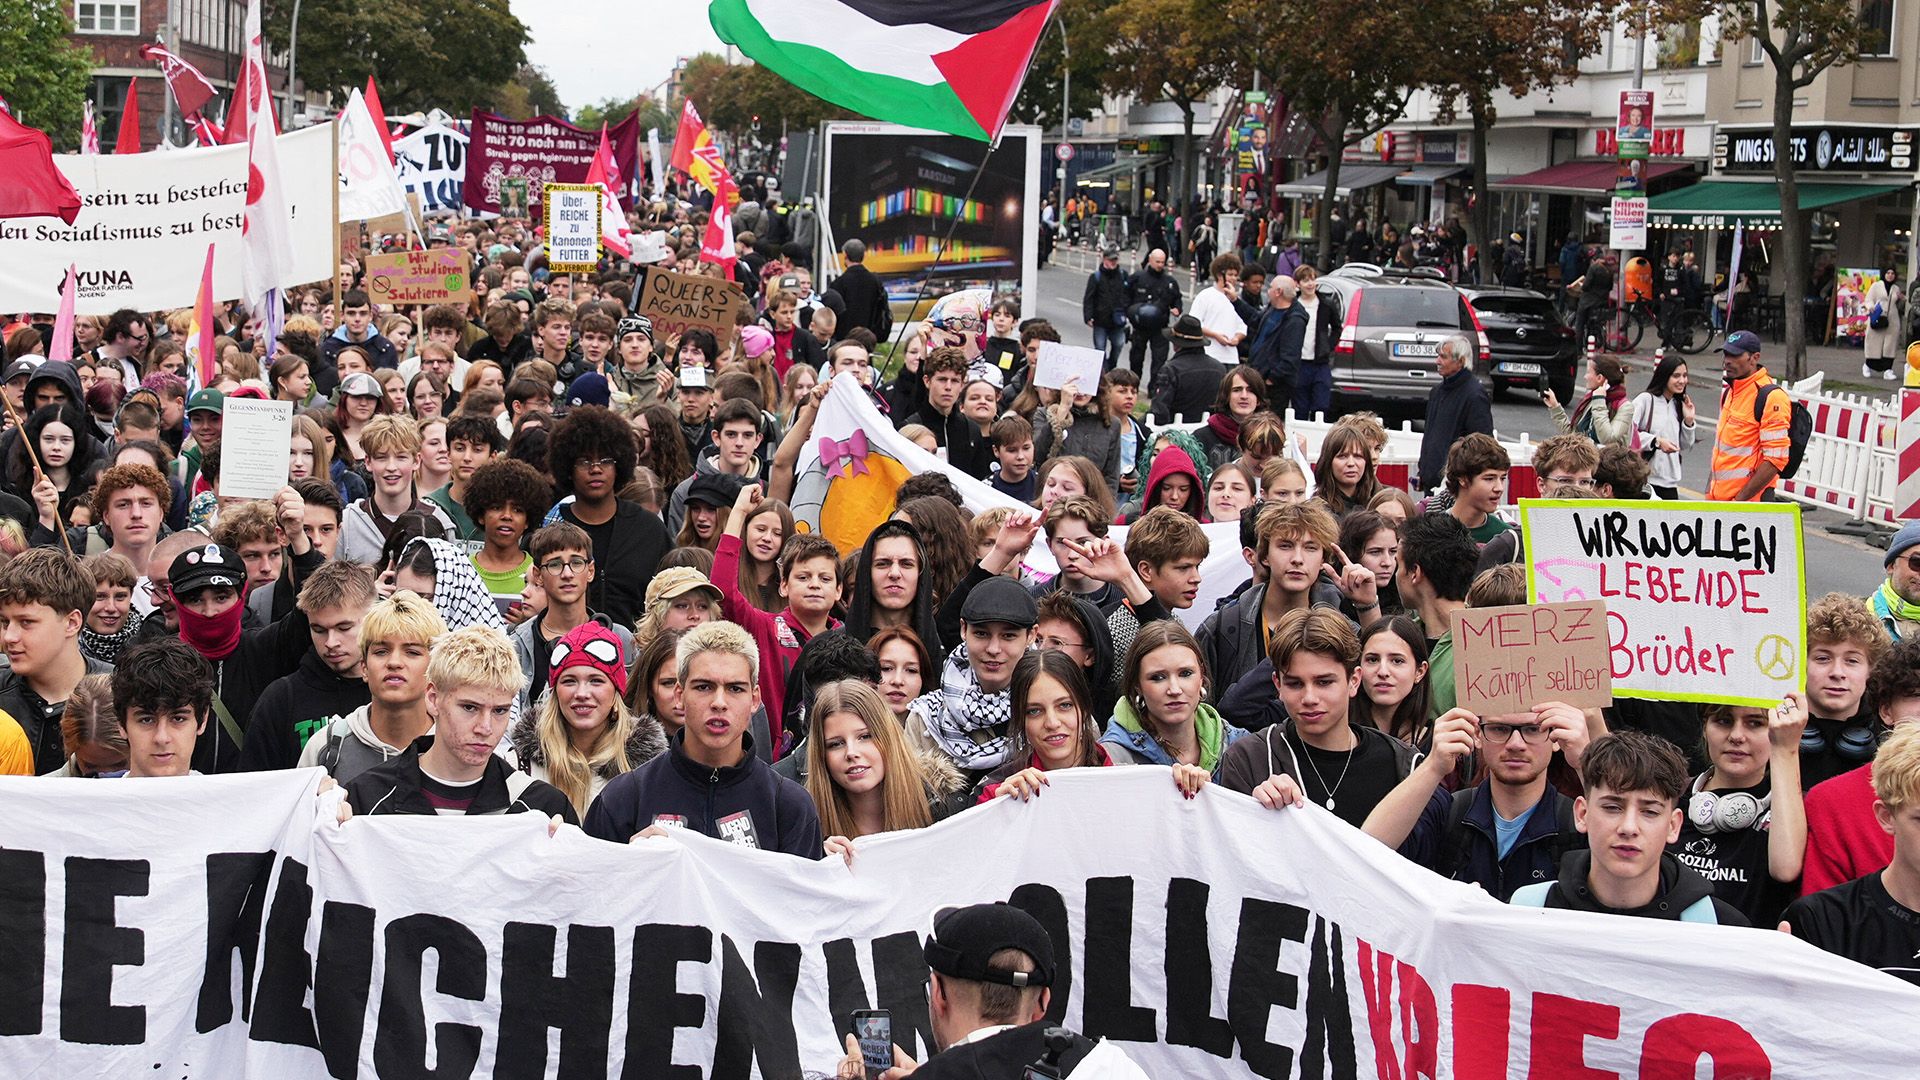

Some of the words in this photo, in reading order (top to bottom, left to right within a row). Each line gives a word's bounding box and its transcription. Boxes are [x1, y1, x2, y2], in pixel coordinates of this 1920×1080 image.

[508, 135, 525, 147] 70
[1735, 139, 1762, 163] KING
[1832, 137, 1864, 163] الشام
[1864, 137, 1886, 163] ملك
[135, 192, 159, 206] zu
[562, 193, 587, 207] Über-
[560, 210, 589, 220] REICHE
[35, 222, 163, 242] Sozialismus
[170, 221, 194, 236] zu
[552, 236, 595, 247] Kanonen-
[407, 253, 429, 263] Wir
[560, 249, 589, 260] FUTTER
[411, 262, 463, 275] studieren
[653, 274, 728, 305] QUEERS
[647, 296, 727, 323] AGAINST
[1573, 511, 1638, 558] WIR
[1639, 517, 1777, 574] WOLLEN
[1600, 562, 1769, 614] LEBENDE
[1461, 607, 1595, 651] MERZ
[1606, 610, 1735, 679] Brüder
[1545, 655, 1610, 692] selber
[1532, 869, 1546, 879] CK
